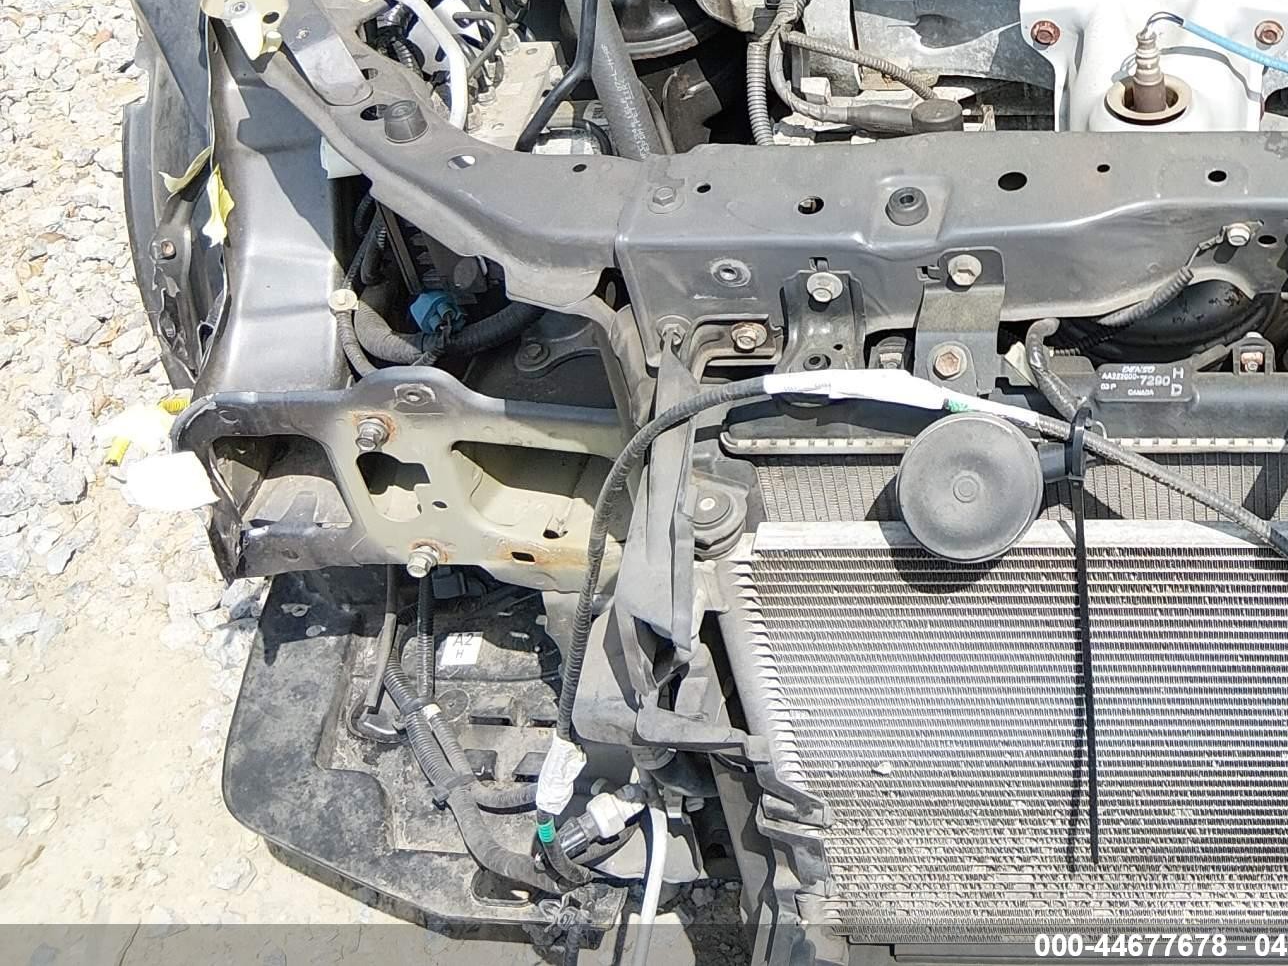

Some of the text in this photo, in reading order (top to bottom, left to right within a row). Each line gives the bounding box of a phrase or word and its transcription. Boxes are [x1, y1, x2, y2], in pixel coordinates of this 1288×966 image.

[1122, 365, 1155, 374] DENSO
[1172, 367, 1184, 379] H
[1171, 383, 1183, 396] D
[452, 633, 474, 647] A2
